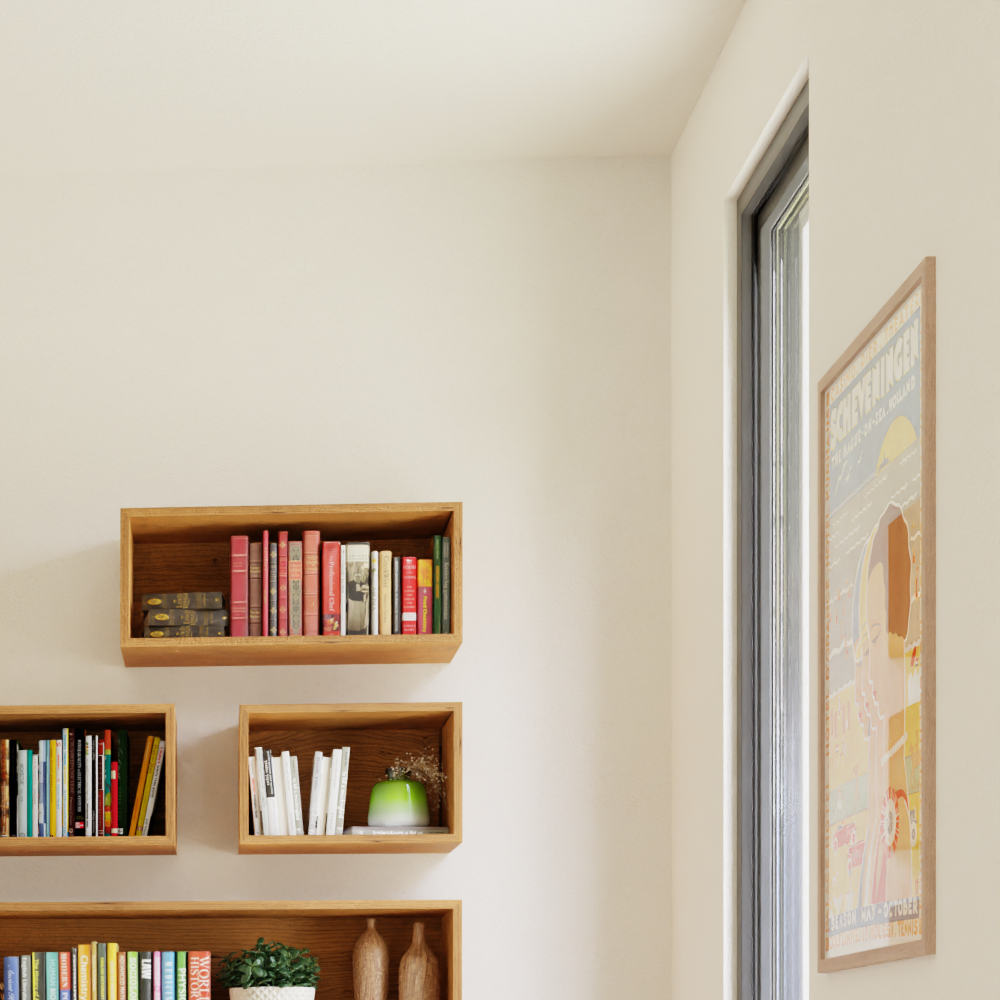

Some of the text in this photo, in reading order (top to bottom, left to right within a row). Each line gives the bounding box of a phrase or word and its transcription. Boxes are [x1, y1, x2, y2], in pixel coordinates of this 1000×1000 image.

[884, 292, 920, 338] THEATER
[830, 317, 919, 452] SCHEVENINGEN
[832, 375, 915, 469] THE HOLLAND
[831, 899, 918, 932] SEASON MAY OCTOBER
[80, 955, 89, 1000] Chemistry
[141, 958, 151, 979] LAW
